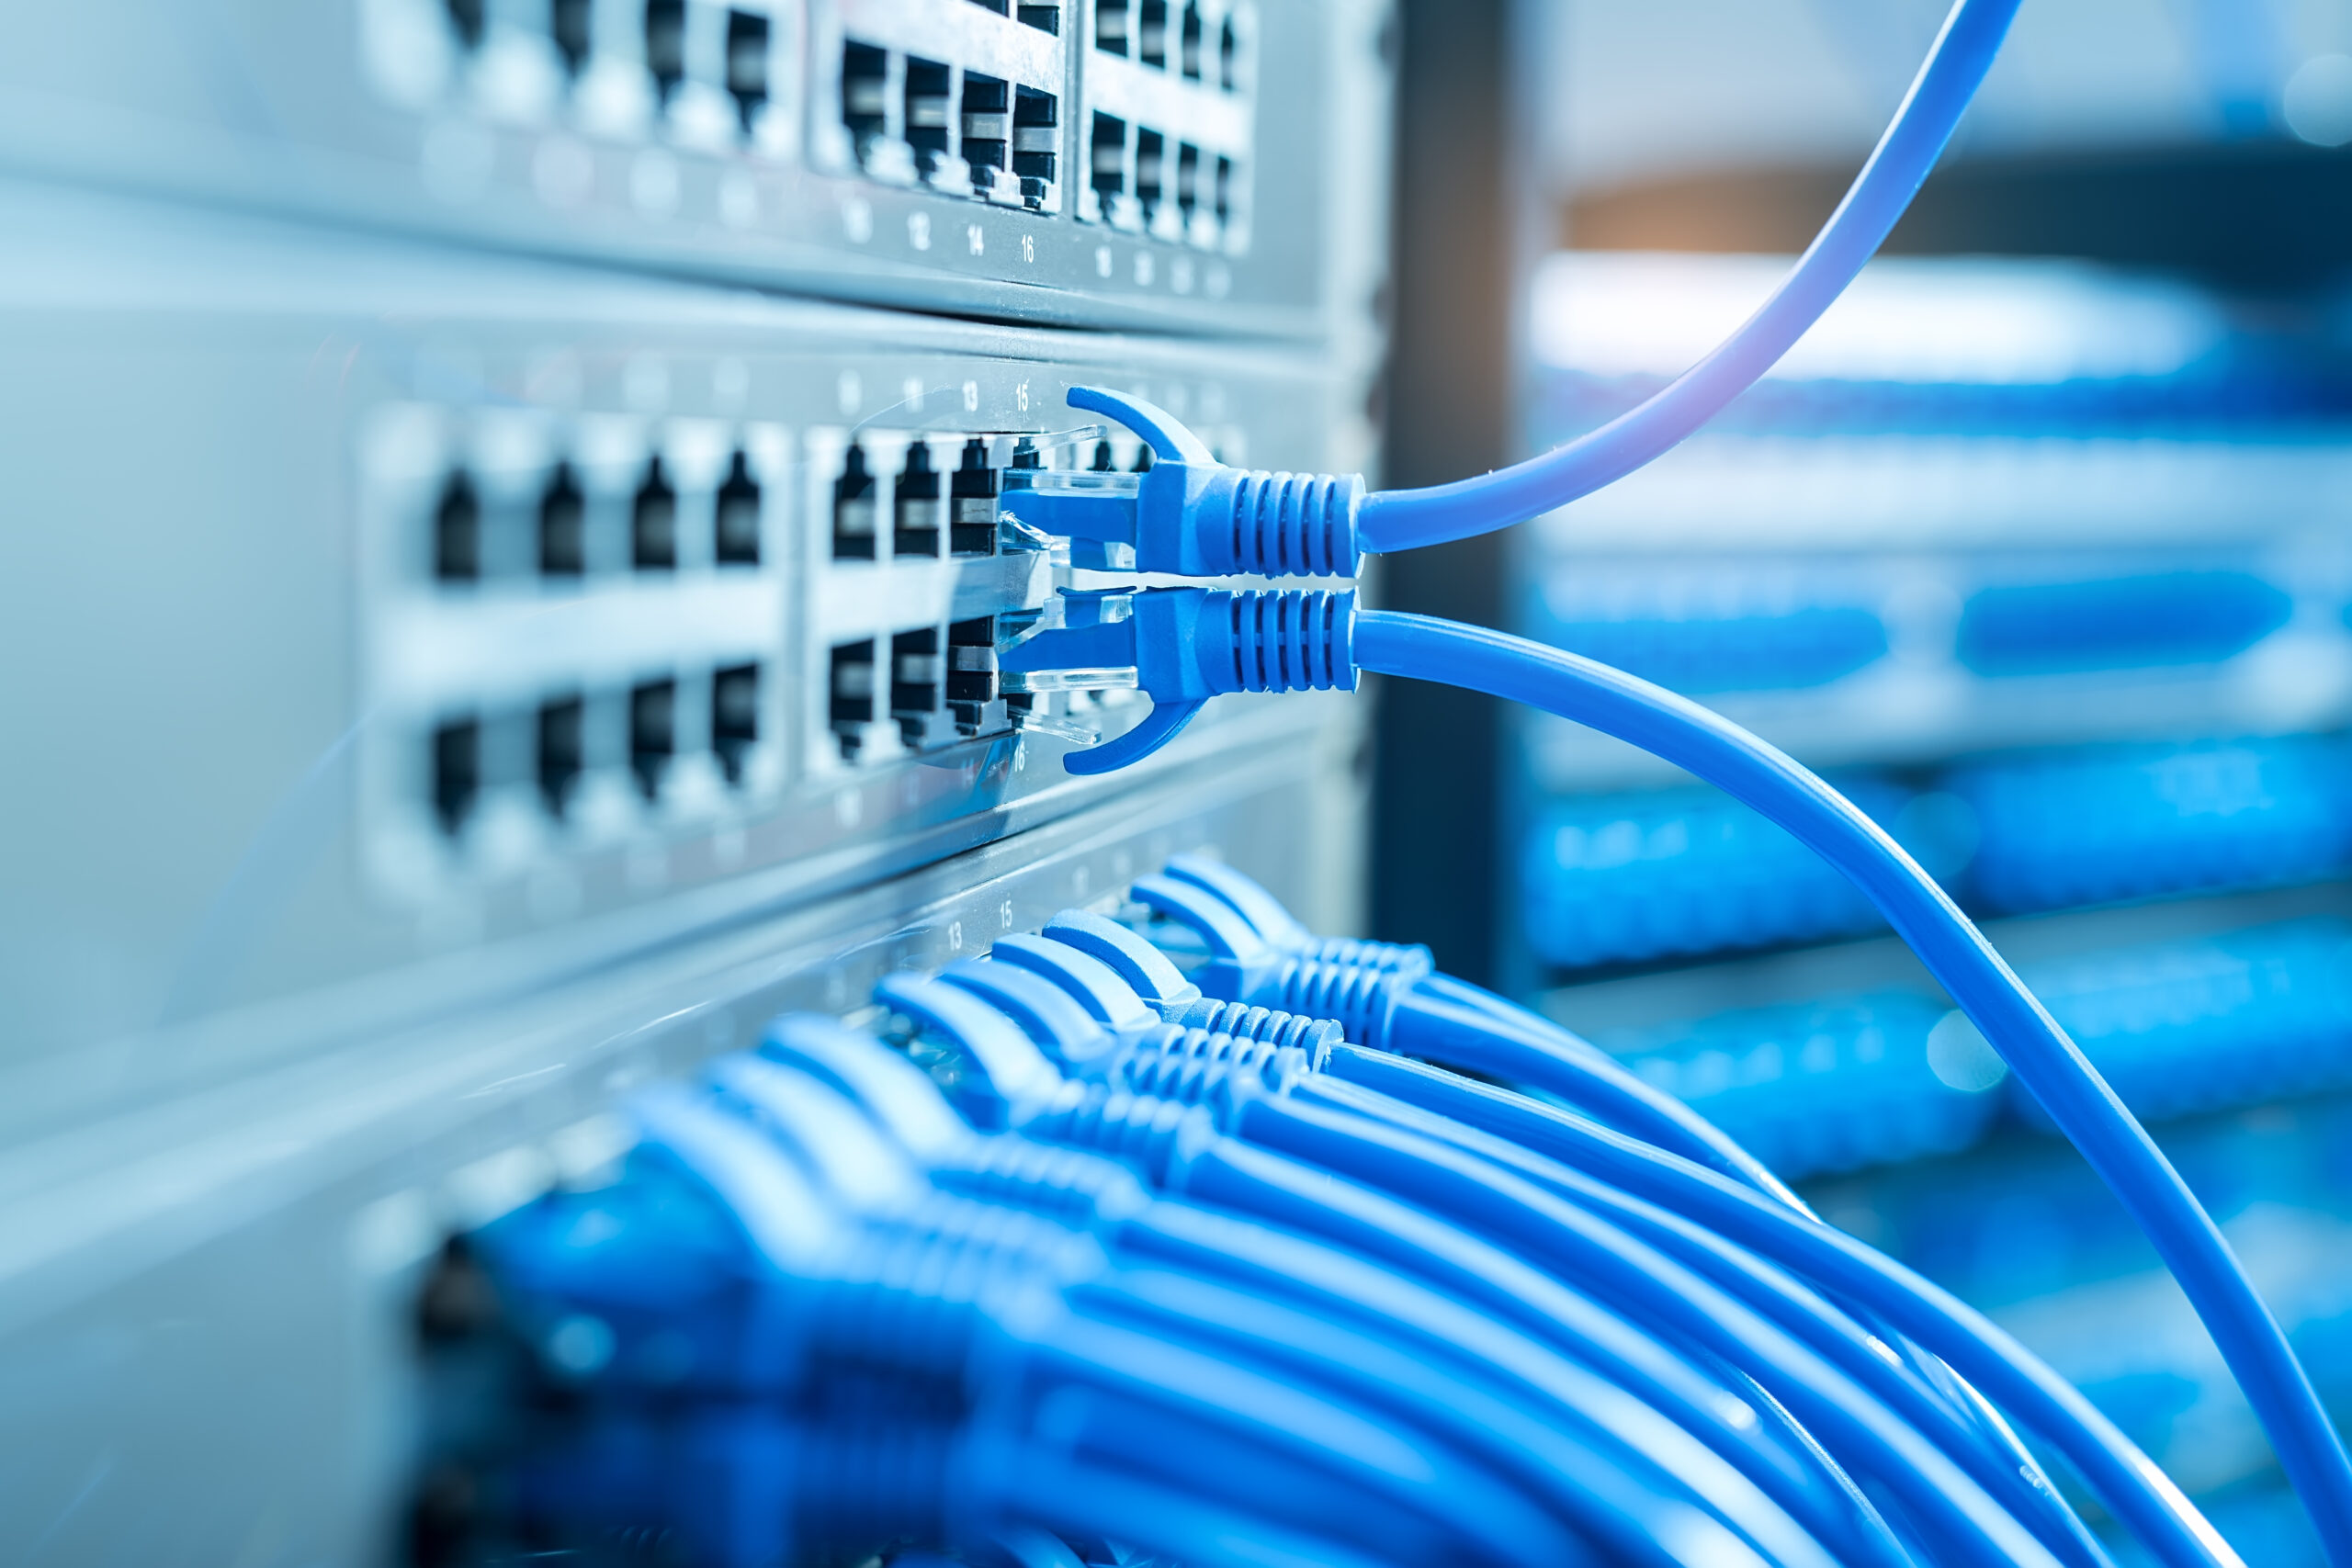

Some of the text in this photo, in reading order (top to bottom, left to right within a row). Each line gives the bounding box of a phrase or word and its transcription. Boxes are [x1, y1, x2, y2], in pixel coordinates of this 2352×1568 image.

[1022, 234, 1035, 264] 16
[1016, 383, 1029, 412] 15
[1014, 741, 1025, 773] 16
[948, 899, 1012, 951] 13 15
